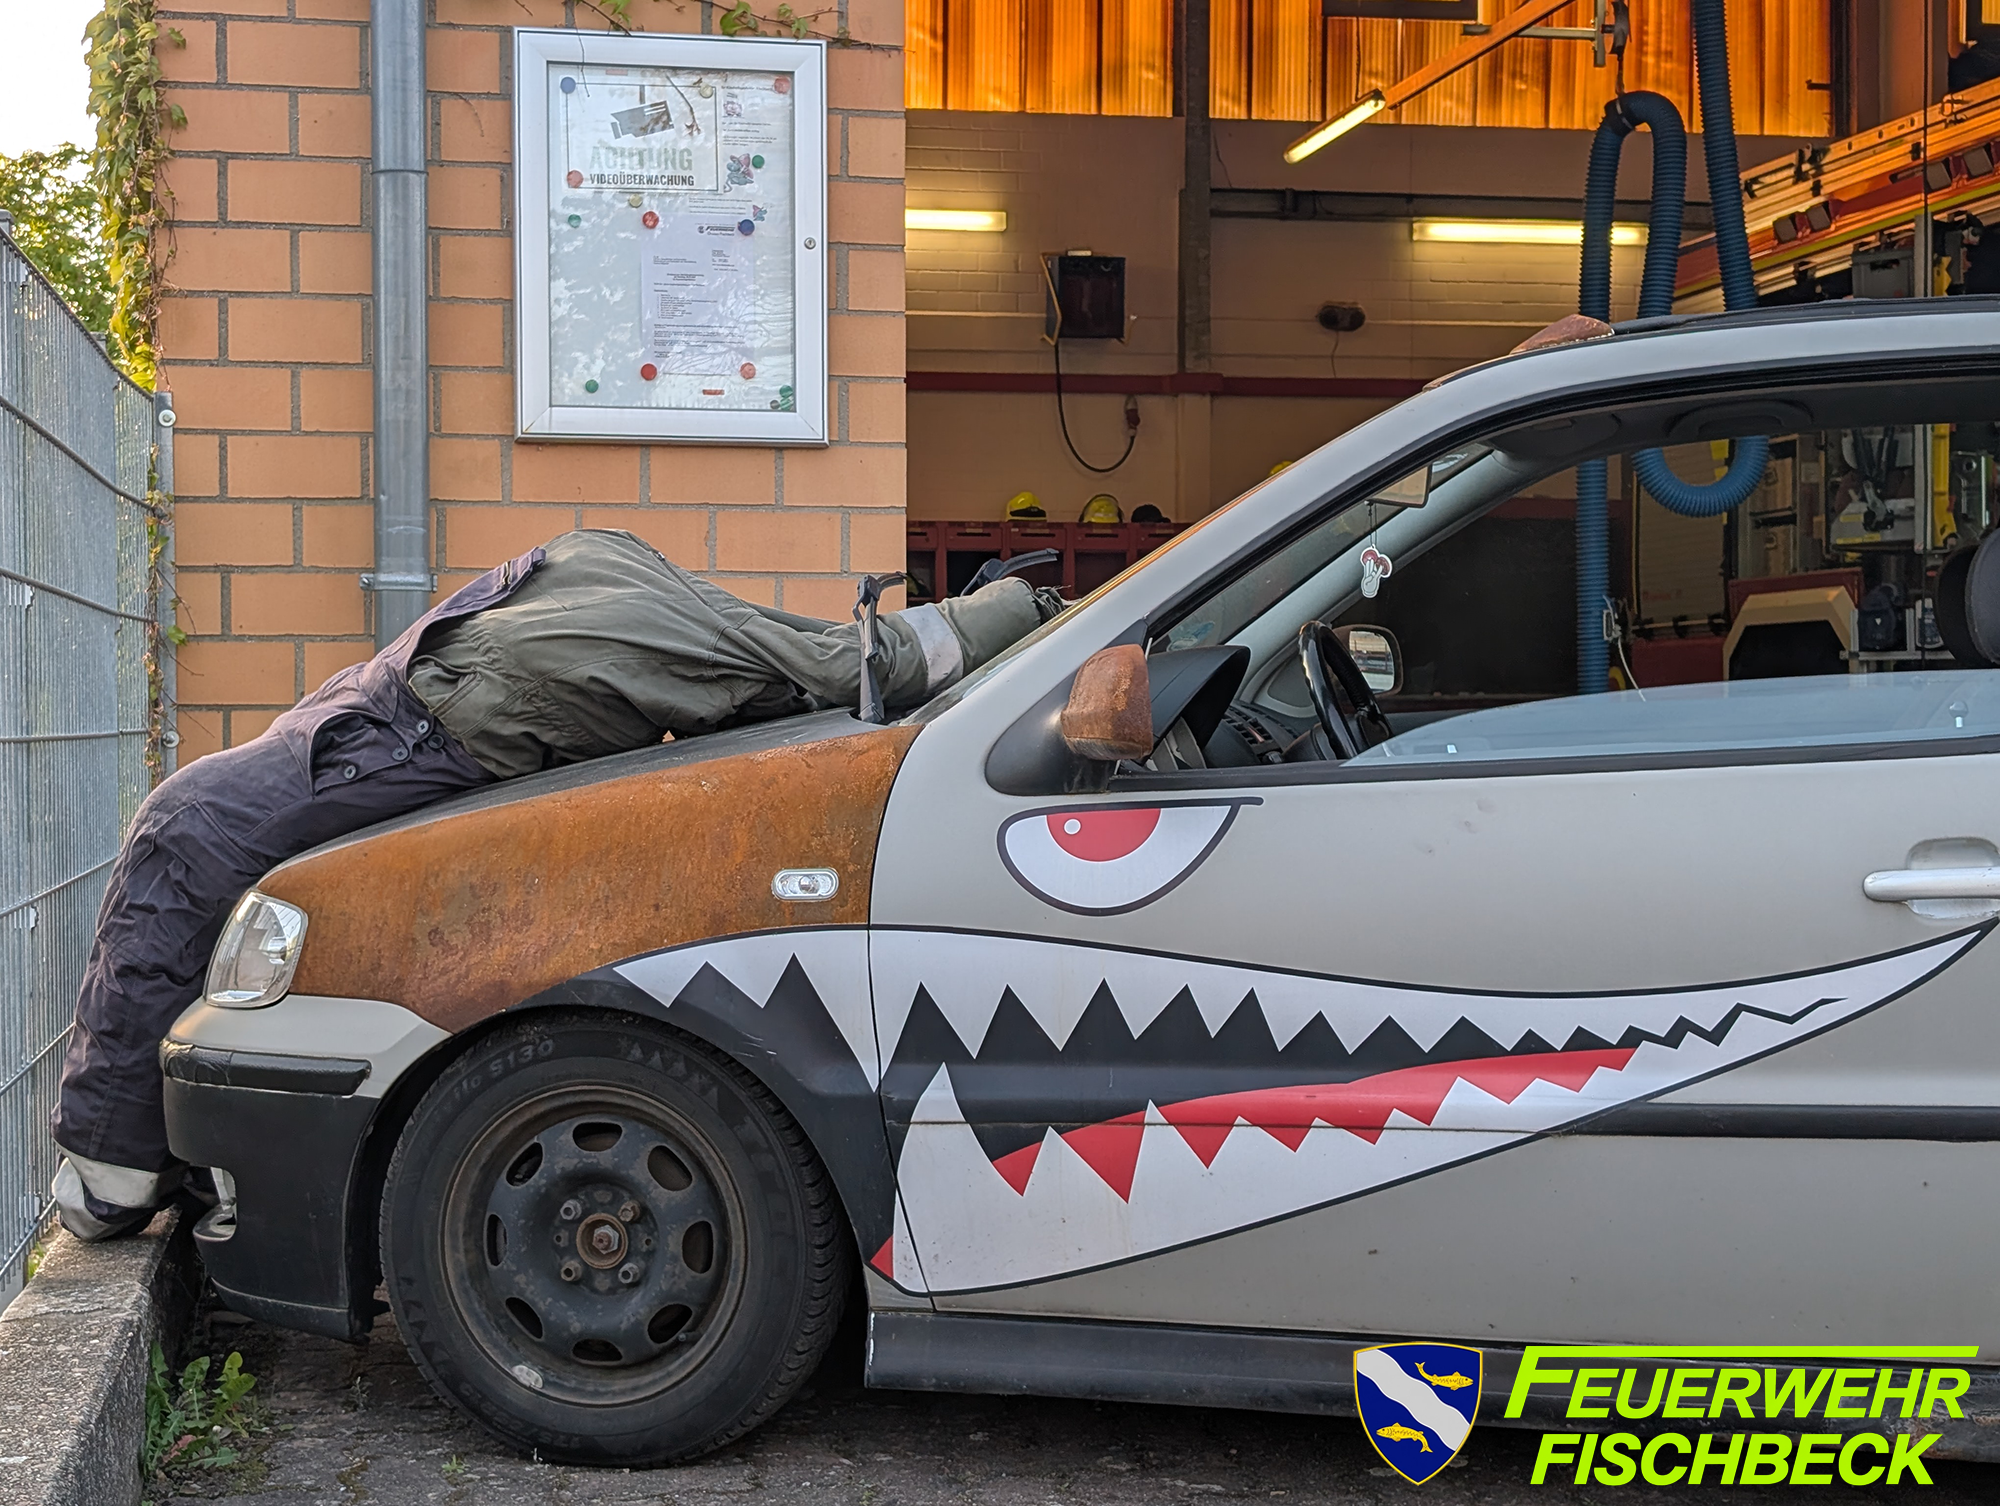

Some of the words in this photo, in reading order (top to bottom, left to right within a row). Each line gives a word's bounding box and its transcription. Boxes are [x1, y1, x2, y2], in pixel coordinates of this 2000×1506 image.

[589, 146, 693, 171] ACHTUNG
[589, 172, 695, 186] VIDEOÜBERWACHUNG
[490, 1039, 554, 1077] S130
